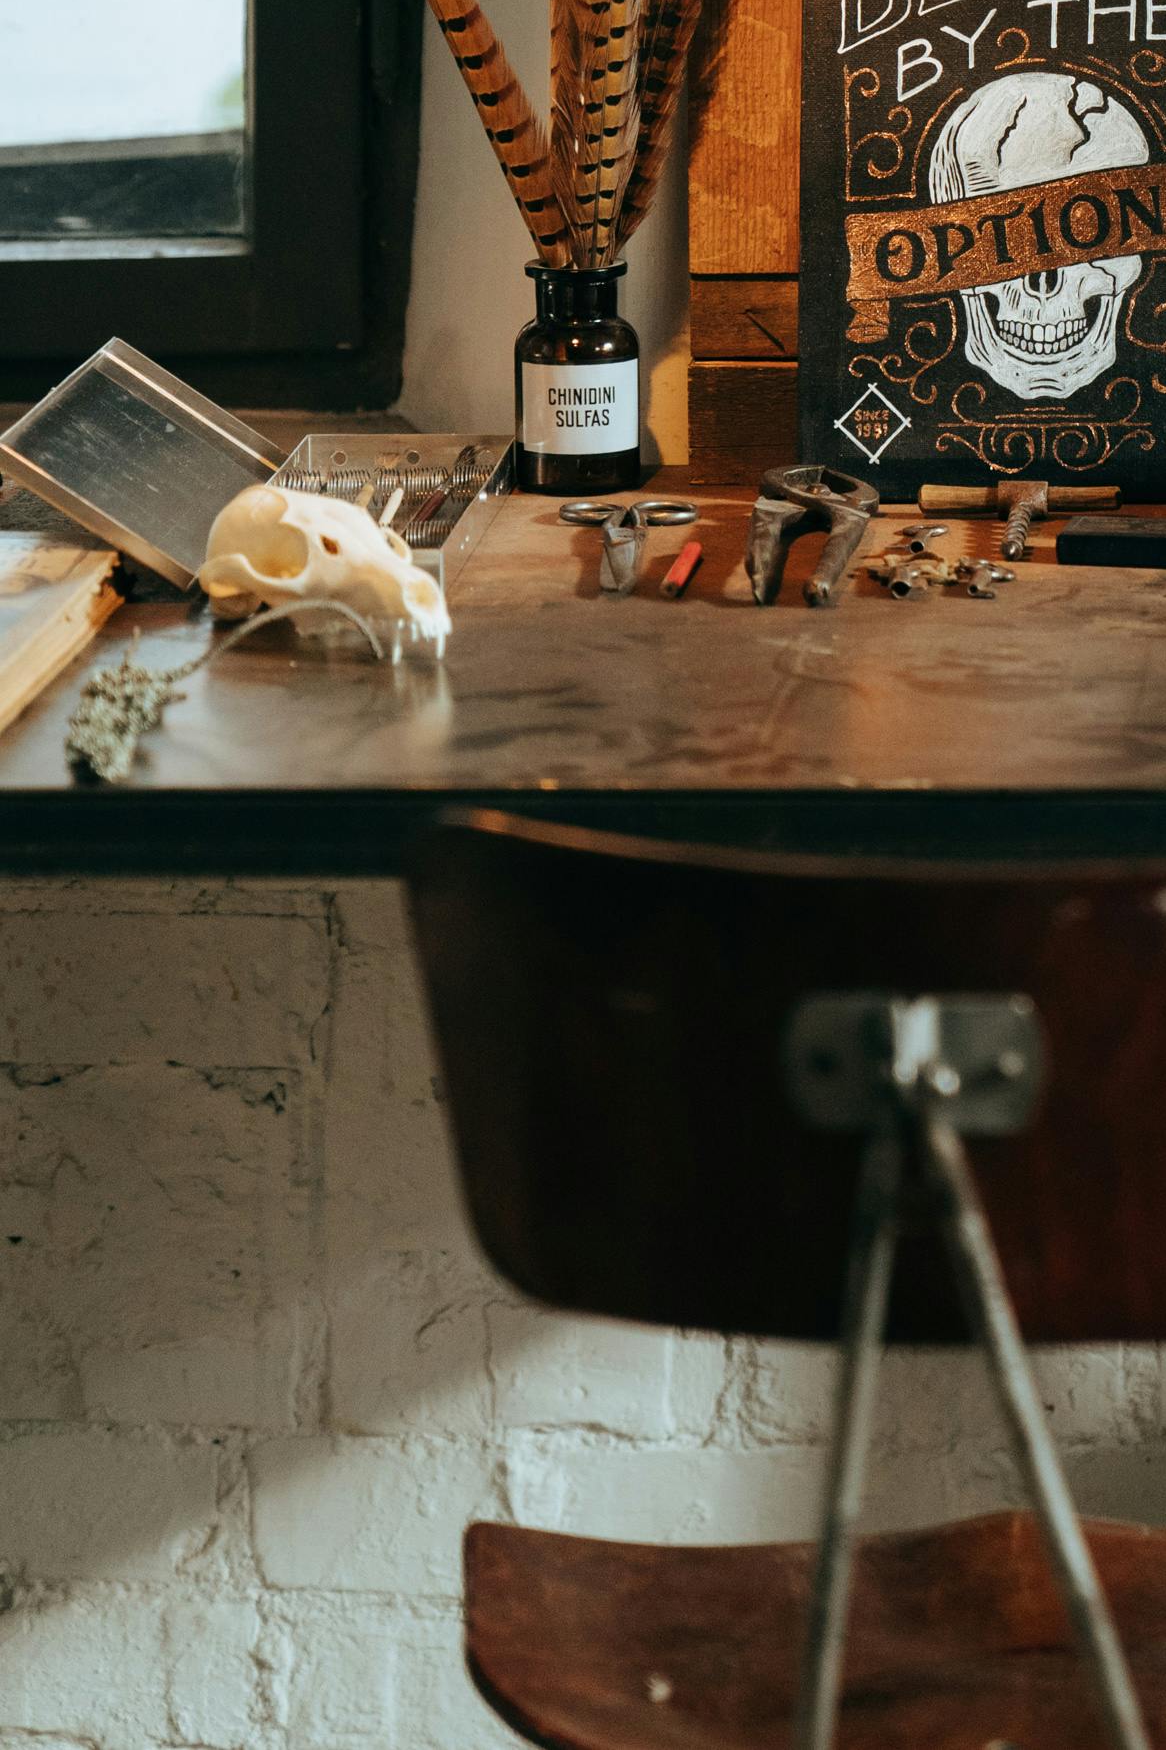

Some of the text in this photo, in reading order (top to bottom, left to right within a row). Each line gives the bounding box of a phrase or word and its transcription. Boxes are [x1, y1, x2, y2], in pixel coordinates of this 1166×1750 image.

[897, 9, 998, 102] BY
[548, 386, 616, 406] CHINIDINI
[556, 410, 610, 427] SULFAS
[854, 409, 890, 421] SINCE
